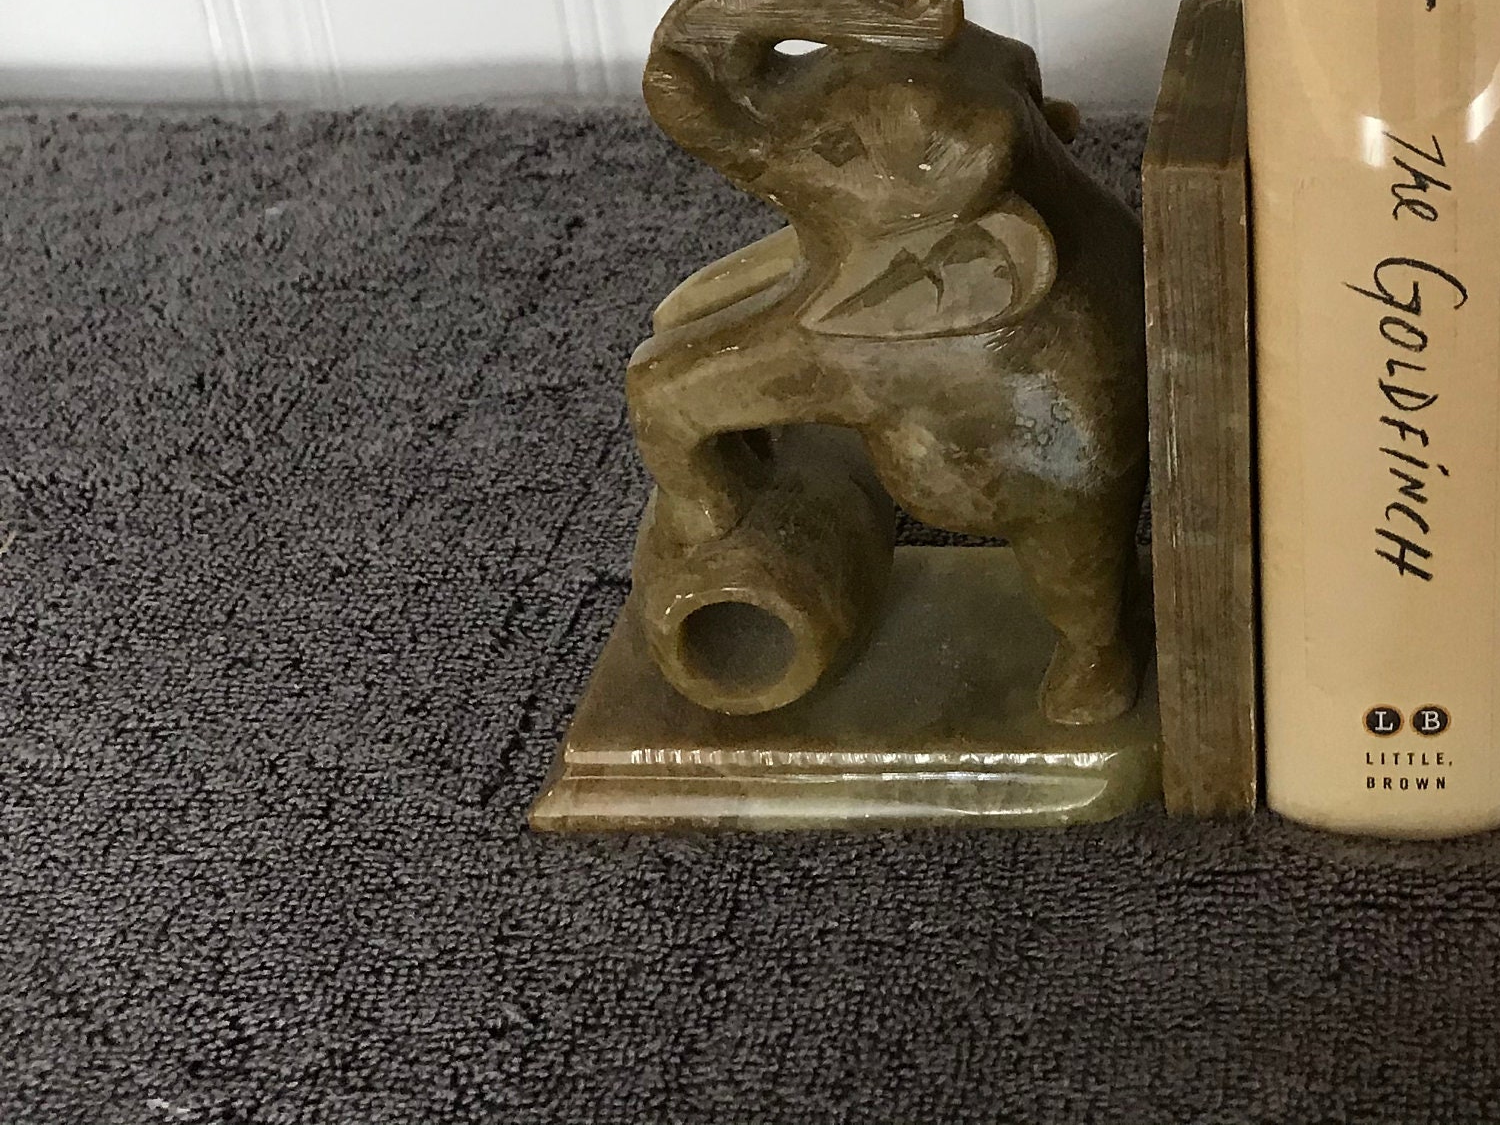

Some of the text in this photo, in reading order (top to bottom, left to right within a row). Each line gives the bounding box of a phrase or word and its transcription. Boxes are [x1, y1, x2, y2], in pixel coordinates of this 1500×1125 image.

[1382, 130, 1452, 221] The
[1374, 710, 1441, 731] L B
[1365, 751, 1453, 767] LITTLE,
[1366, 776, 1446, 790] BROWN
